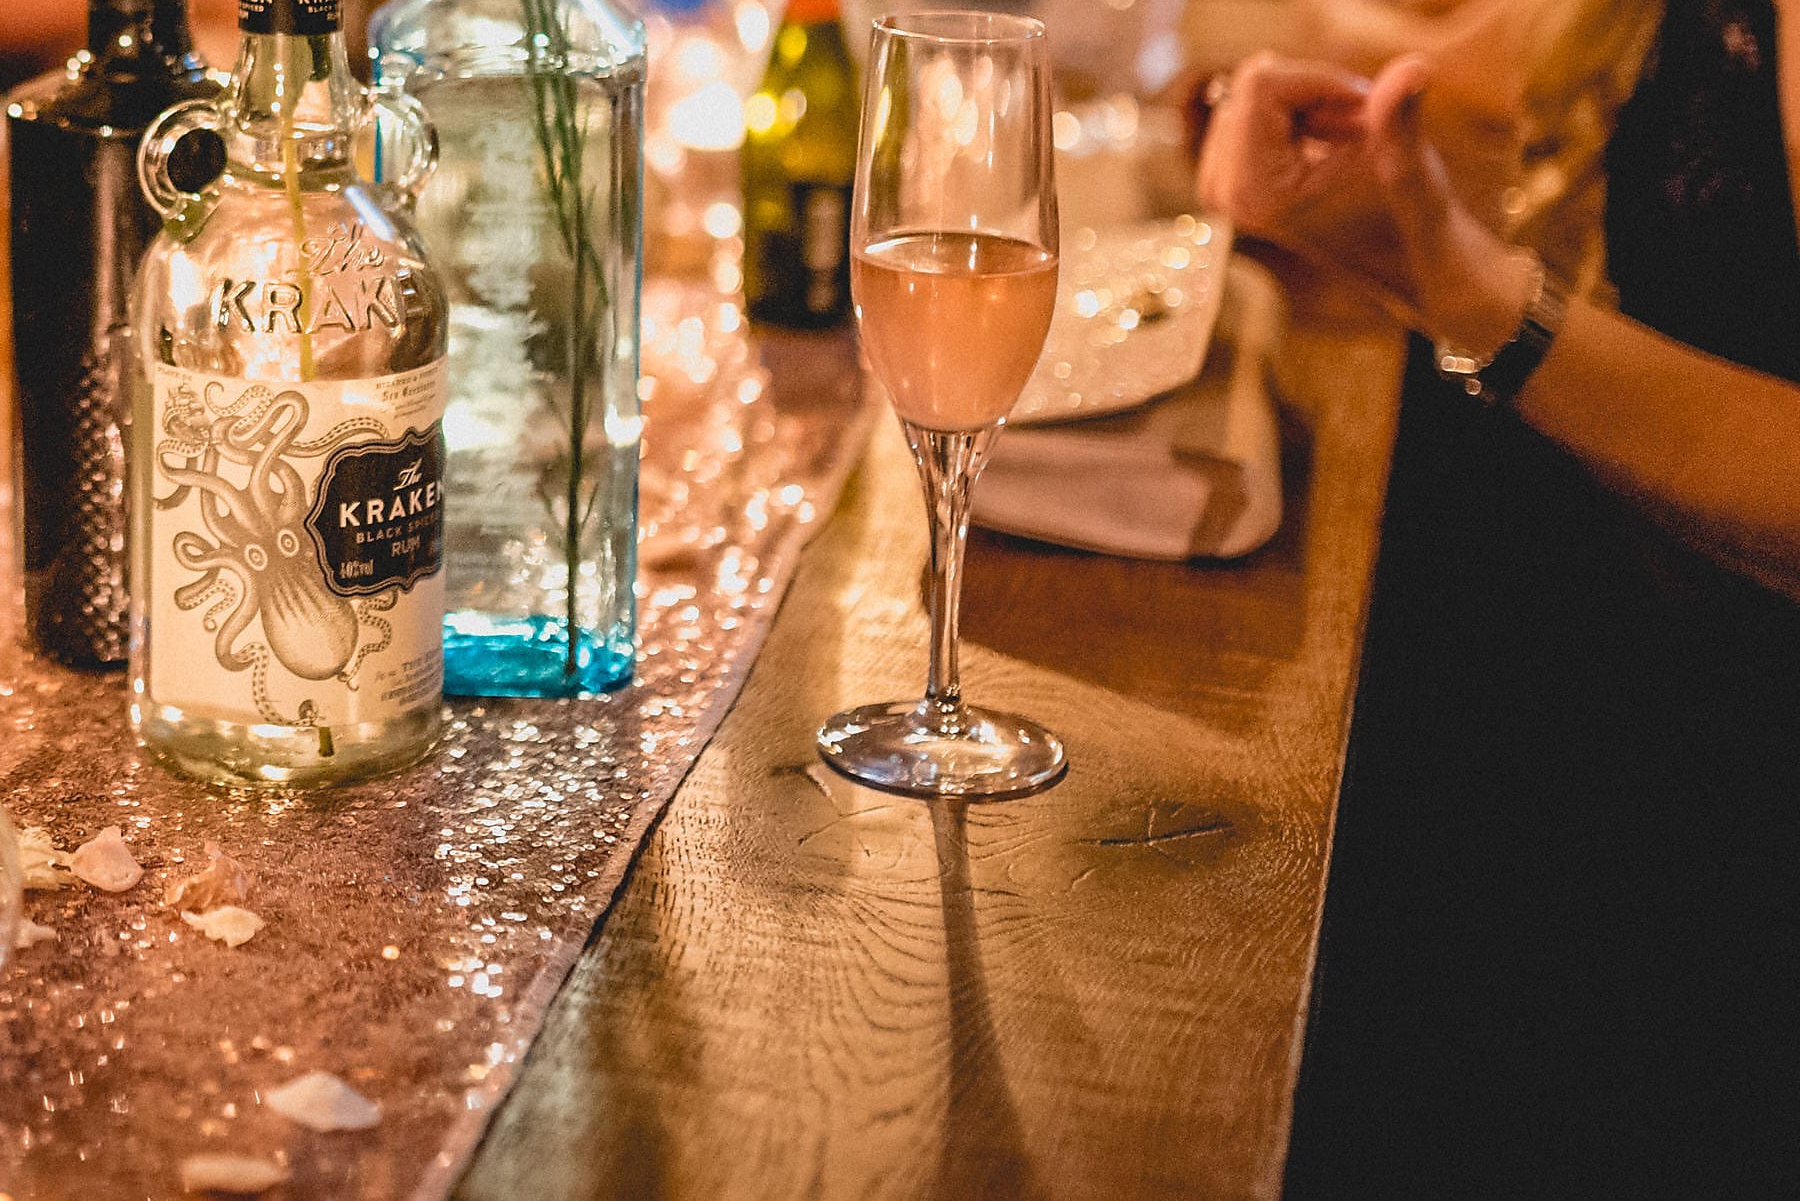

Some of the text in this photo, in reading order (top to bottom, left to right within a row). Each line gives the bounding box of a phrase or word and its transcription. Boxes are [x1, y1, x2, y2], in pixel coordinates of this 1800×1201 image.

[299, 224, 384, 276] The
[393, 457, 423, 492] The
[355, 525, 403, 545] BLACK
[391, 535, 422, 558] RUM
